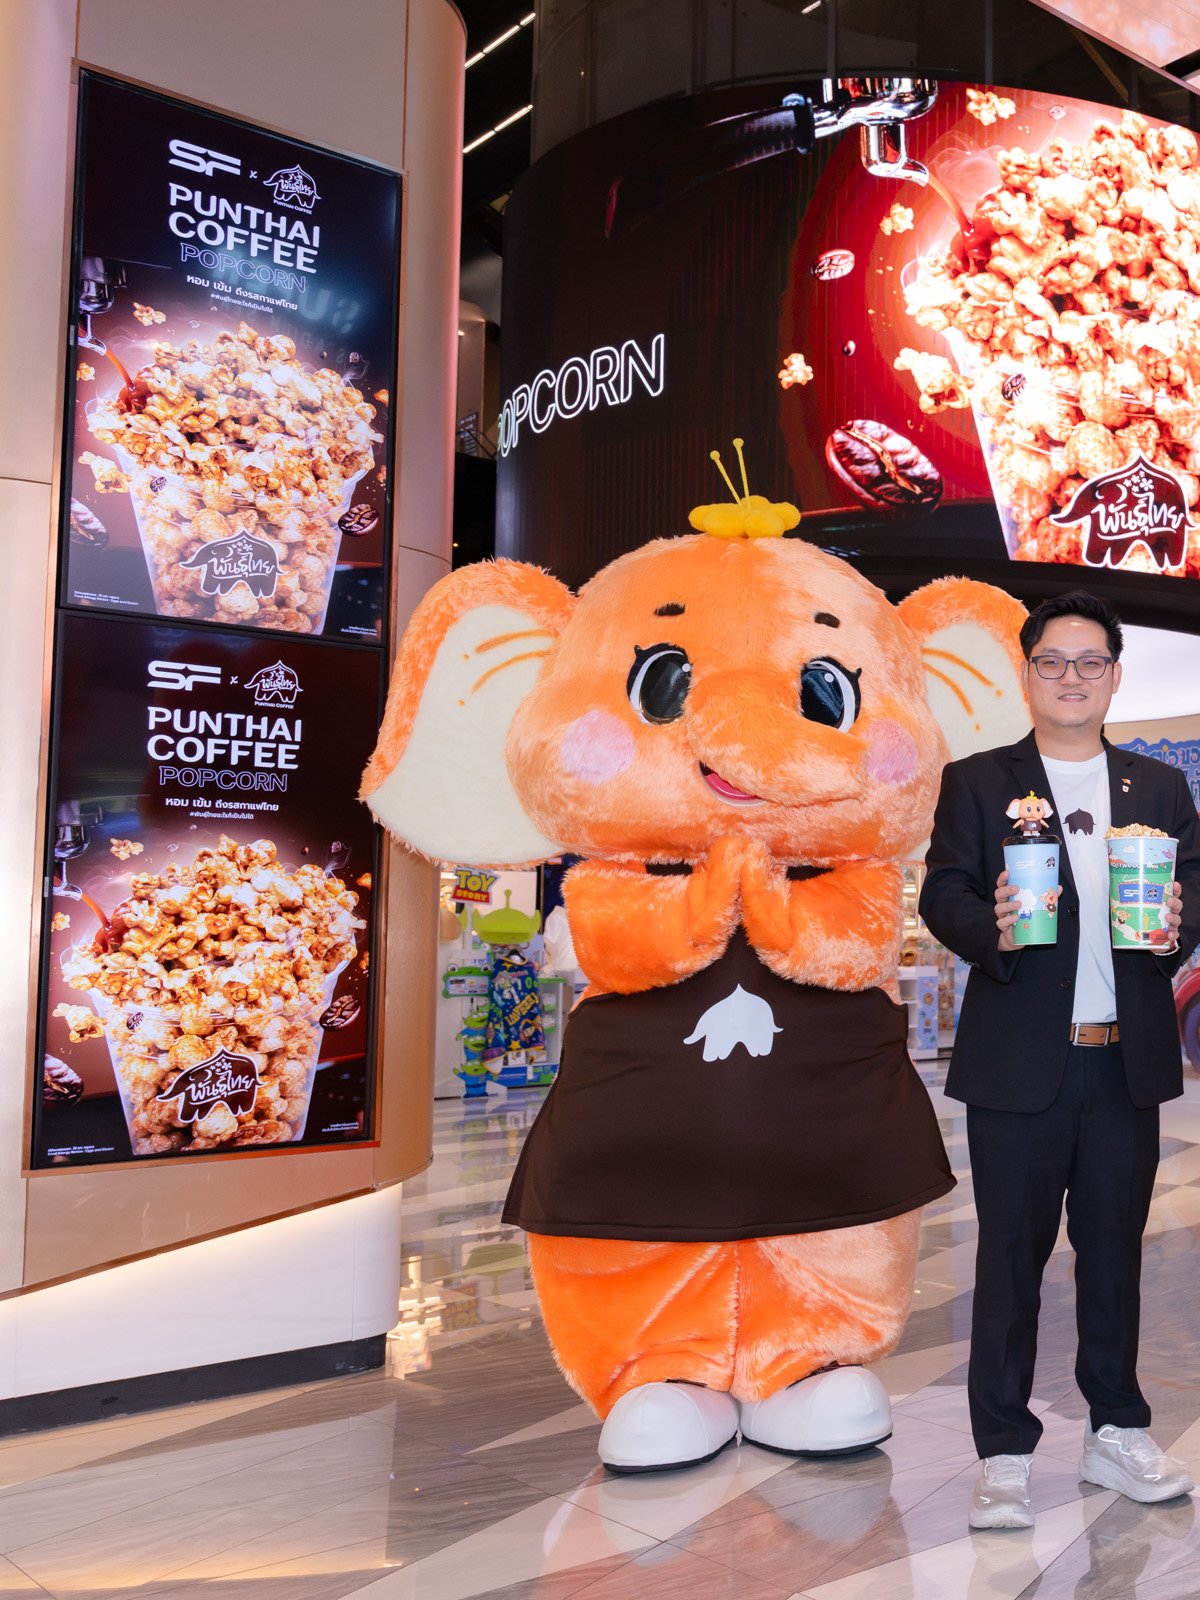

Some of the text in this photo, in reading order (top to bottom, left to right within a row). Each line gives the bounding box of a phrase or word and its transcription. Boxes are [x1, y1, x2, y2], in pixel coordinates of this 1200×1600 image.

[168, 139, 241, 176] SF
[168, 182, 320, 248] PUNTHAI
[168, 211, 318, 274] COFFEE
[180, 242, 306, 293] POPCORN
[186, 275, 210, 288] หอม
[213, 281, 232, 293] เข้ม
[498, 333, 665, 458] OPCORN
[1090, 491, 1184, 537] พันธุ์ไทย
[209, 552, 276, 578] พันธุ์ไทย
[147, 660, 221, 691] SF
[147, 706, 302, 742] PUNTHAI
[147, 734, 300, 770] COFFEE
[159, 765, 288, 792] POPCORN
[165, 797, 189, 807] หอม
[193, 796, 212, 808] เข้ม
[455, 889, 488, 902] STORY
[456, 870, 496, 892] TOY
[187, 1070, 253, 1102] พันธุ์ไทย
